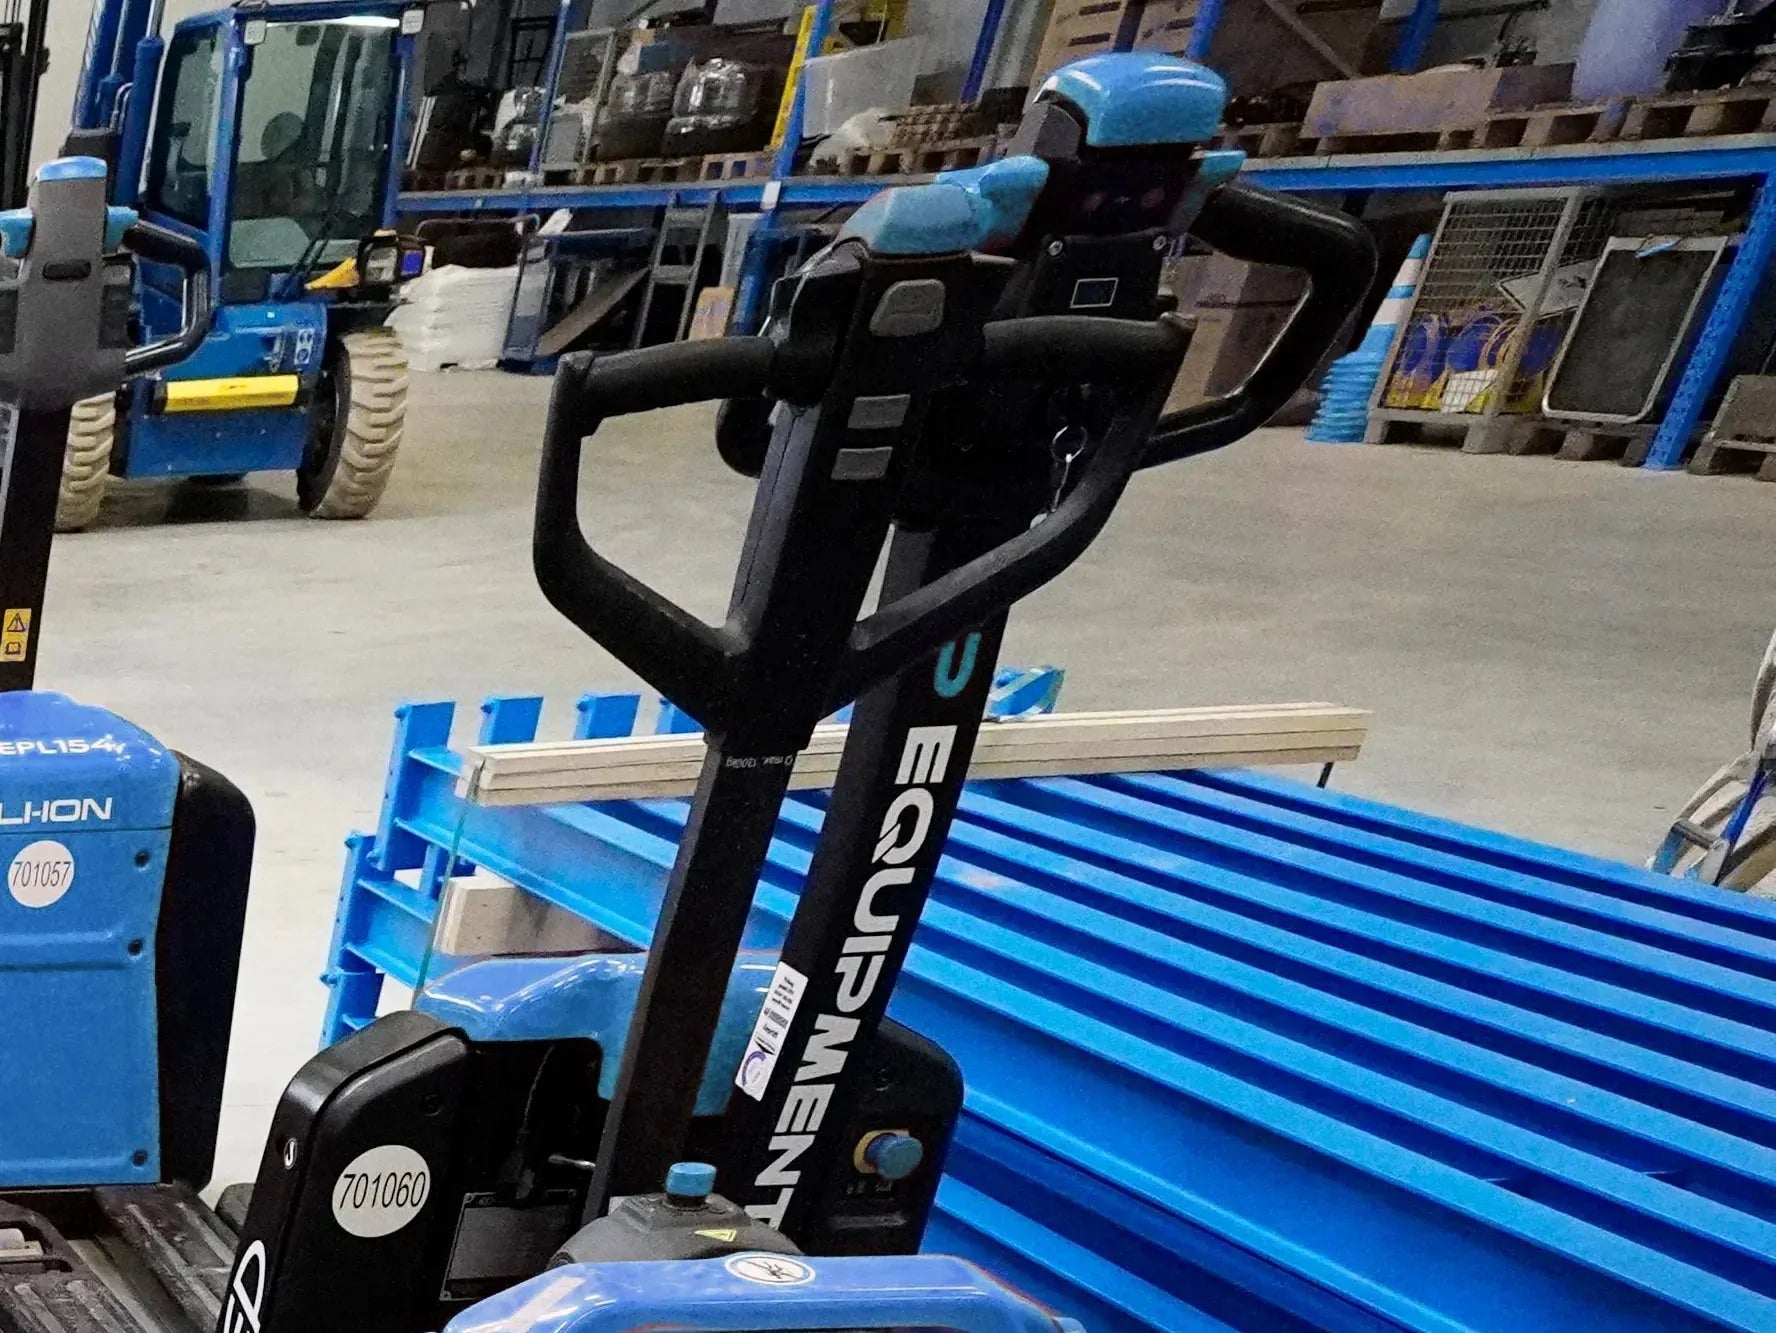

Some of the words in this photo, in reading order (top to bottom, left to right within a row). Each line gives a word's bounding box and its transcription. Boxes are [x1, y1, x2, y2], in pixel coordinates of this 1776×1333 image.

[12, 861, 72, 888] 701057
[745, 725, 958, 1231] EQUIPMENT
[339, 1171, 426, 1210] 701060
